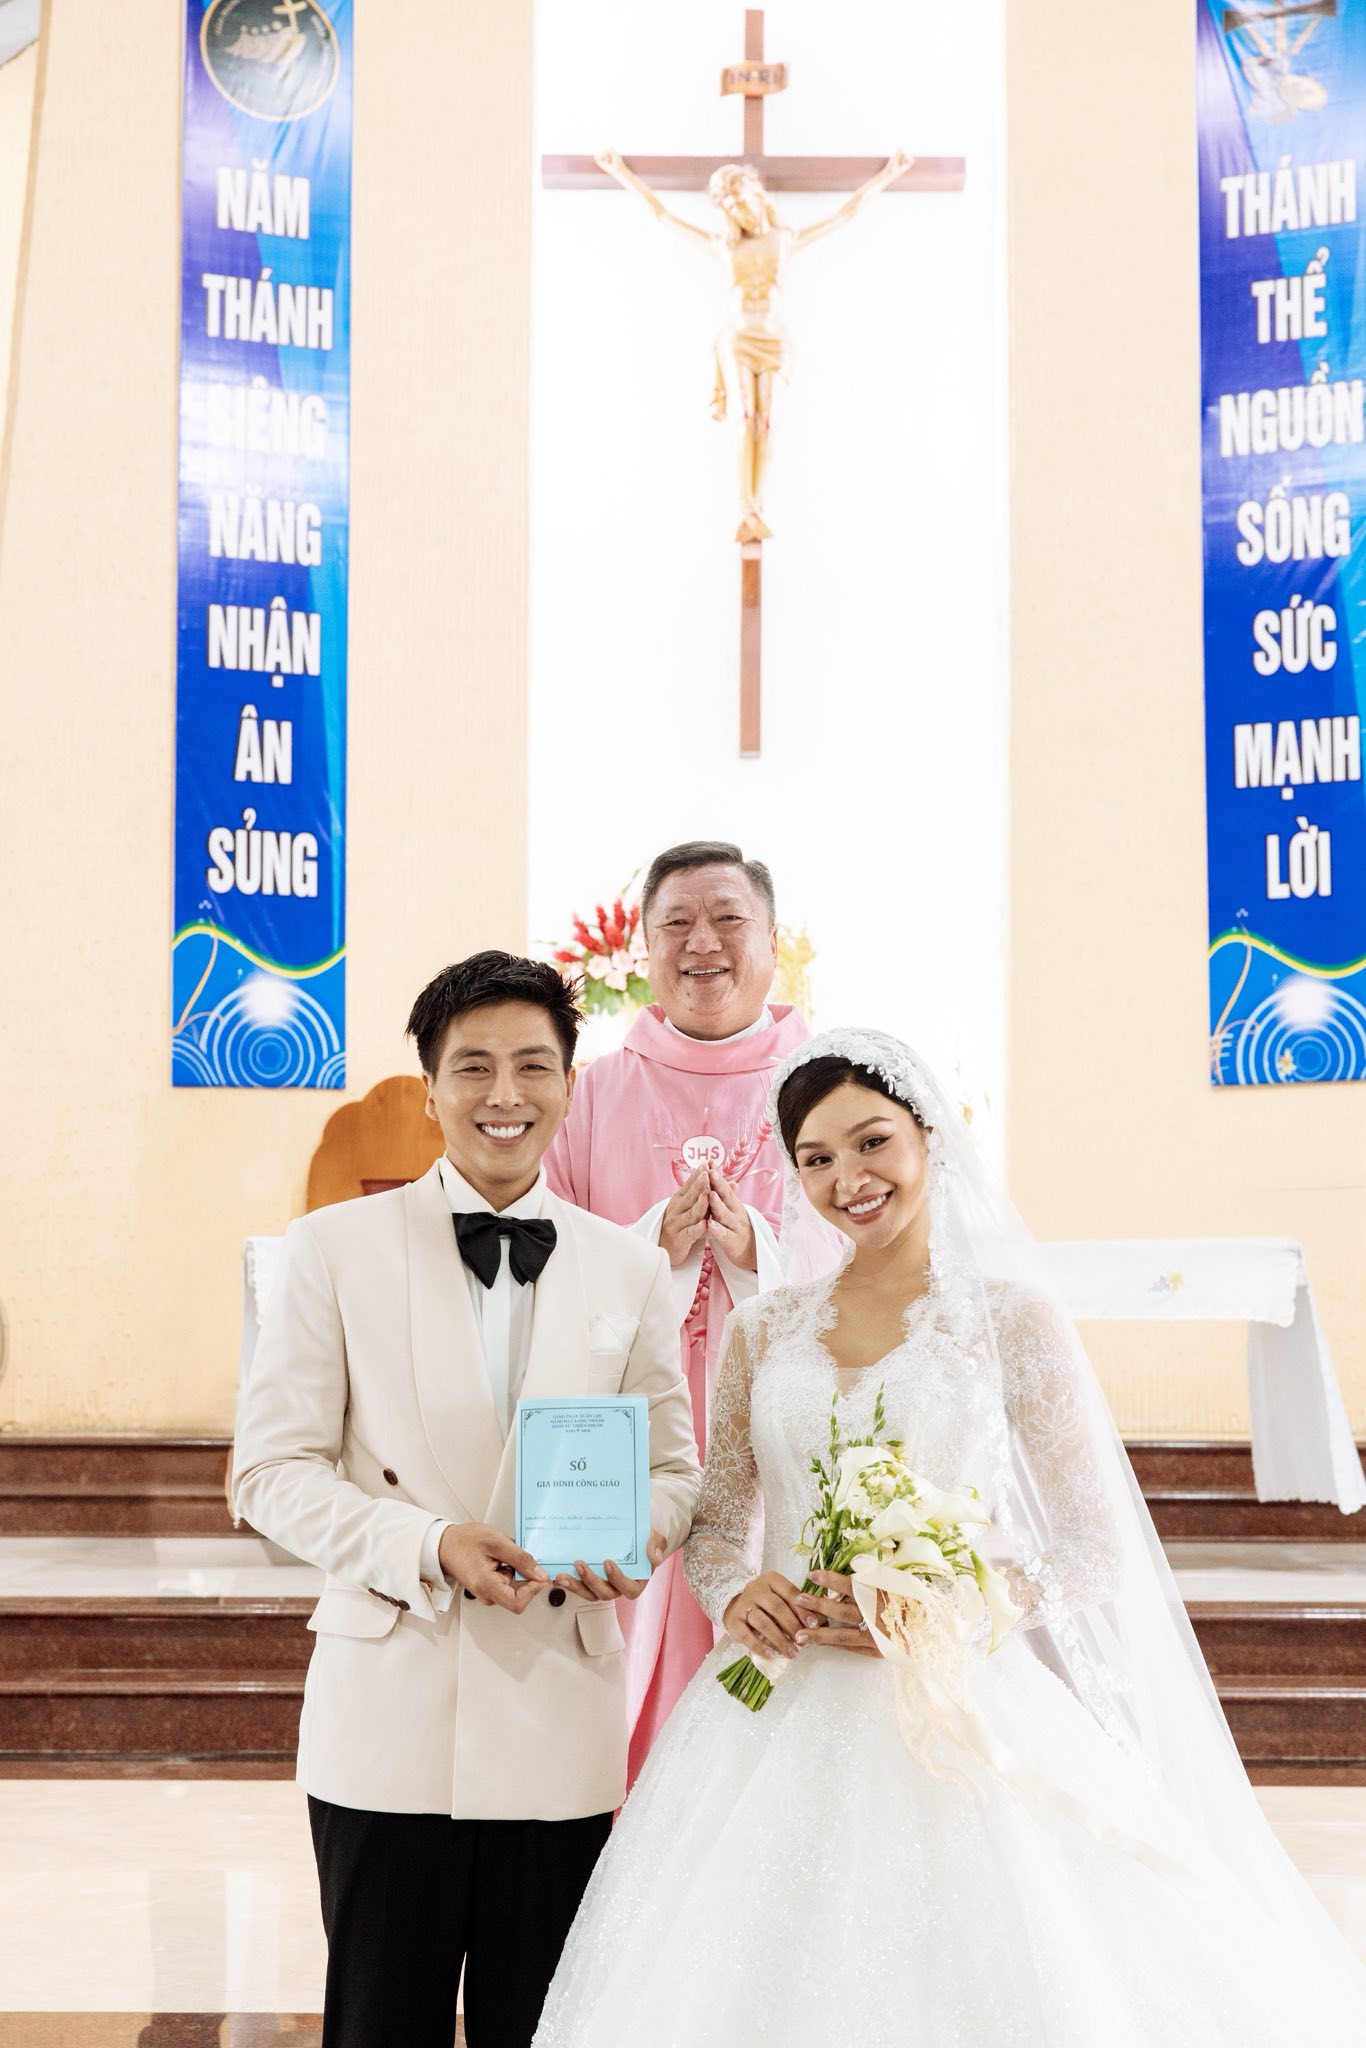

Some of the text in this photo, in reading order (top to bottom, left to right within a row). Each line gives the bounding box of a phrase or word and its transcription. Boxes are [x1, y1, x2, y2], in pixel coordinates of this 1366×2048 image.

[215, 157, 311, 240] NĂM
[1220, 155, 1357, 238] THÁNH
[202, 268, 334, 351] THÁNH
[1251, 246, 1328, 345] THỂ
[1219, 361, 1365, 458] NGUỒN
[209, 483, 323, 567] NĂNG
[1236, 475, 1351, 567] SỐNG
[207, 596, 321, 688] NHẬN
[1252, 593, 1338, 676] SỨC
[234, 704, 293, 785] ÂN
[1234, 715, 1361, 800] MẠNH
[206, 808, 319, 898] SỦNG
[1266, 816, 1332, 900] LỜI
[688, 1146, 720, 1160] JHS
[536, 1480, 551, 1488] GIA
[575, 1479, 598, 1488] CÔNG
[599, 1478, 620, 1487] GIÁO
[569, 1457, 587, 1471] SỔ
